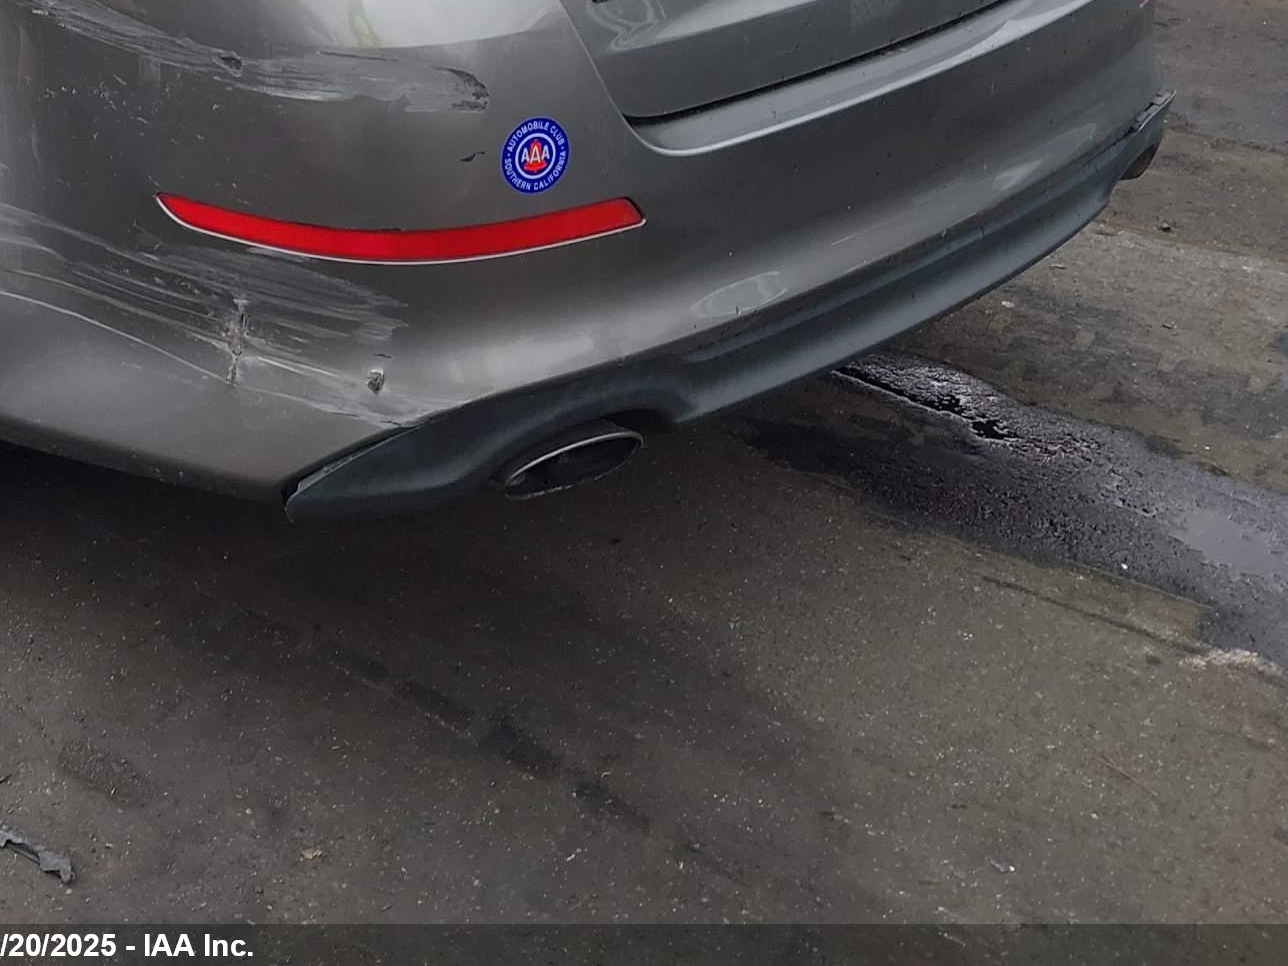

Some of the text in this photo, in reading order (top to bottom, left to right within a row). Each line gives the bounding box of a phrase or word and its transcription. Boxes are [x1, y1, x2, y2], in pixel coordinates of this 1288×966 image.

[507, 120, 566, 153] AUTOMOBILE CLUB
[504, 150, 567, 191] SOUTHERN CALIFORNIA
[520, 144, 550, 164] AAA
